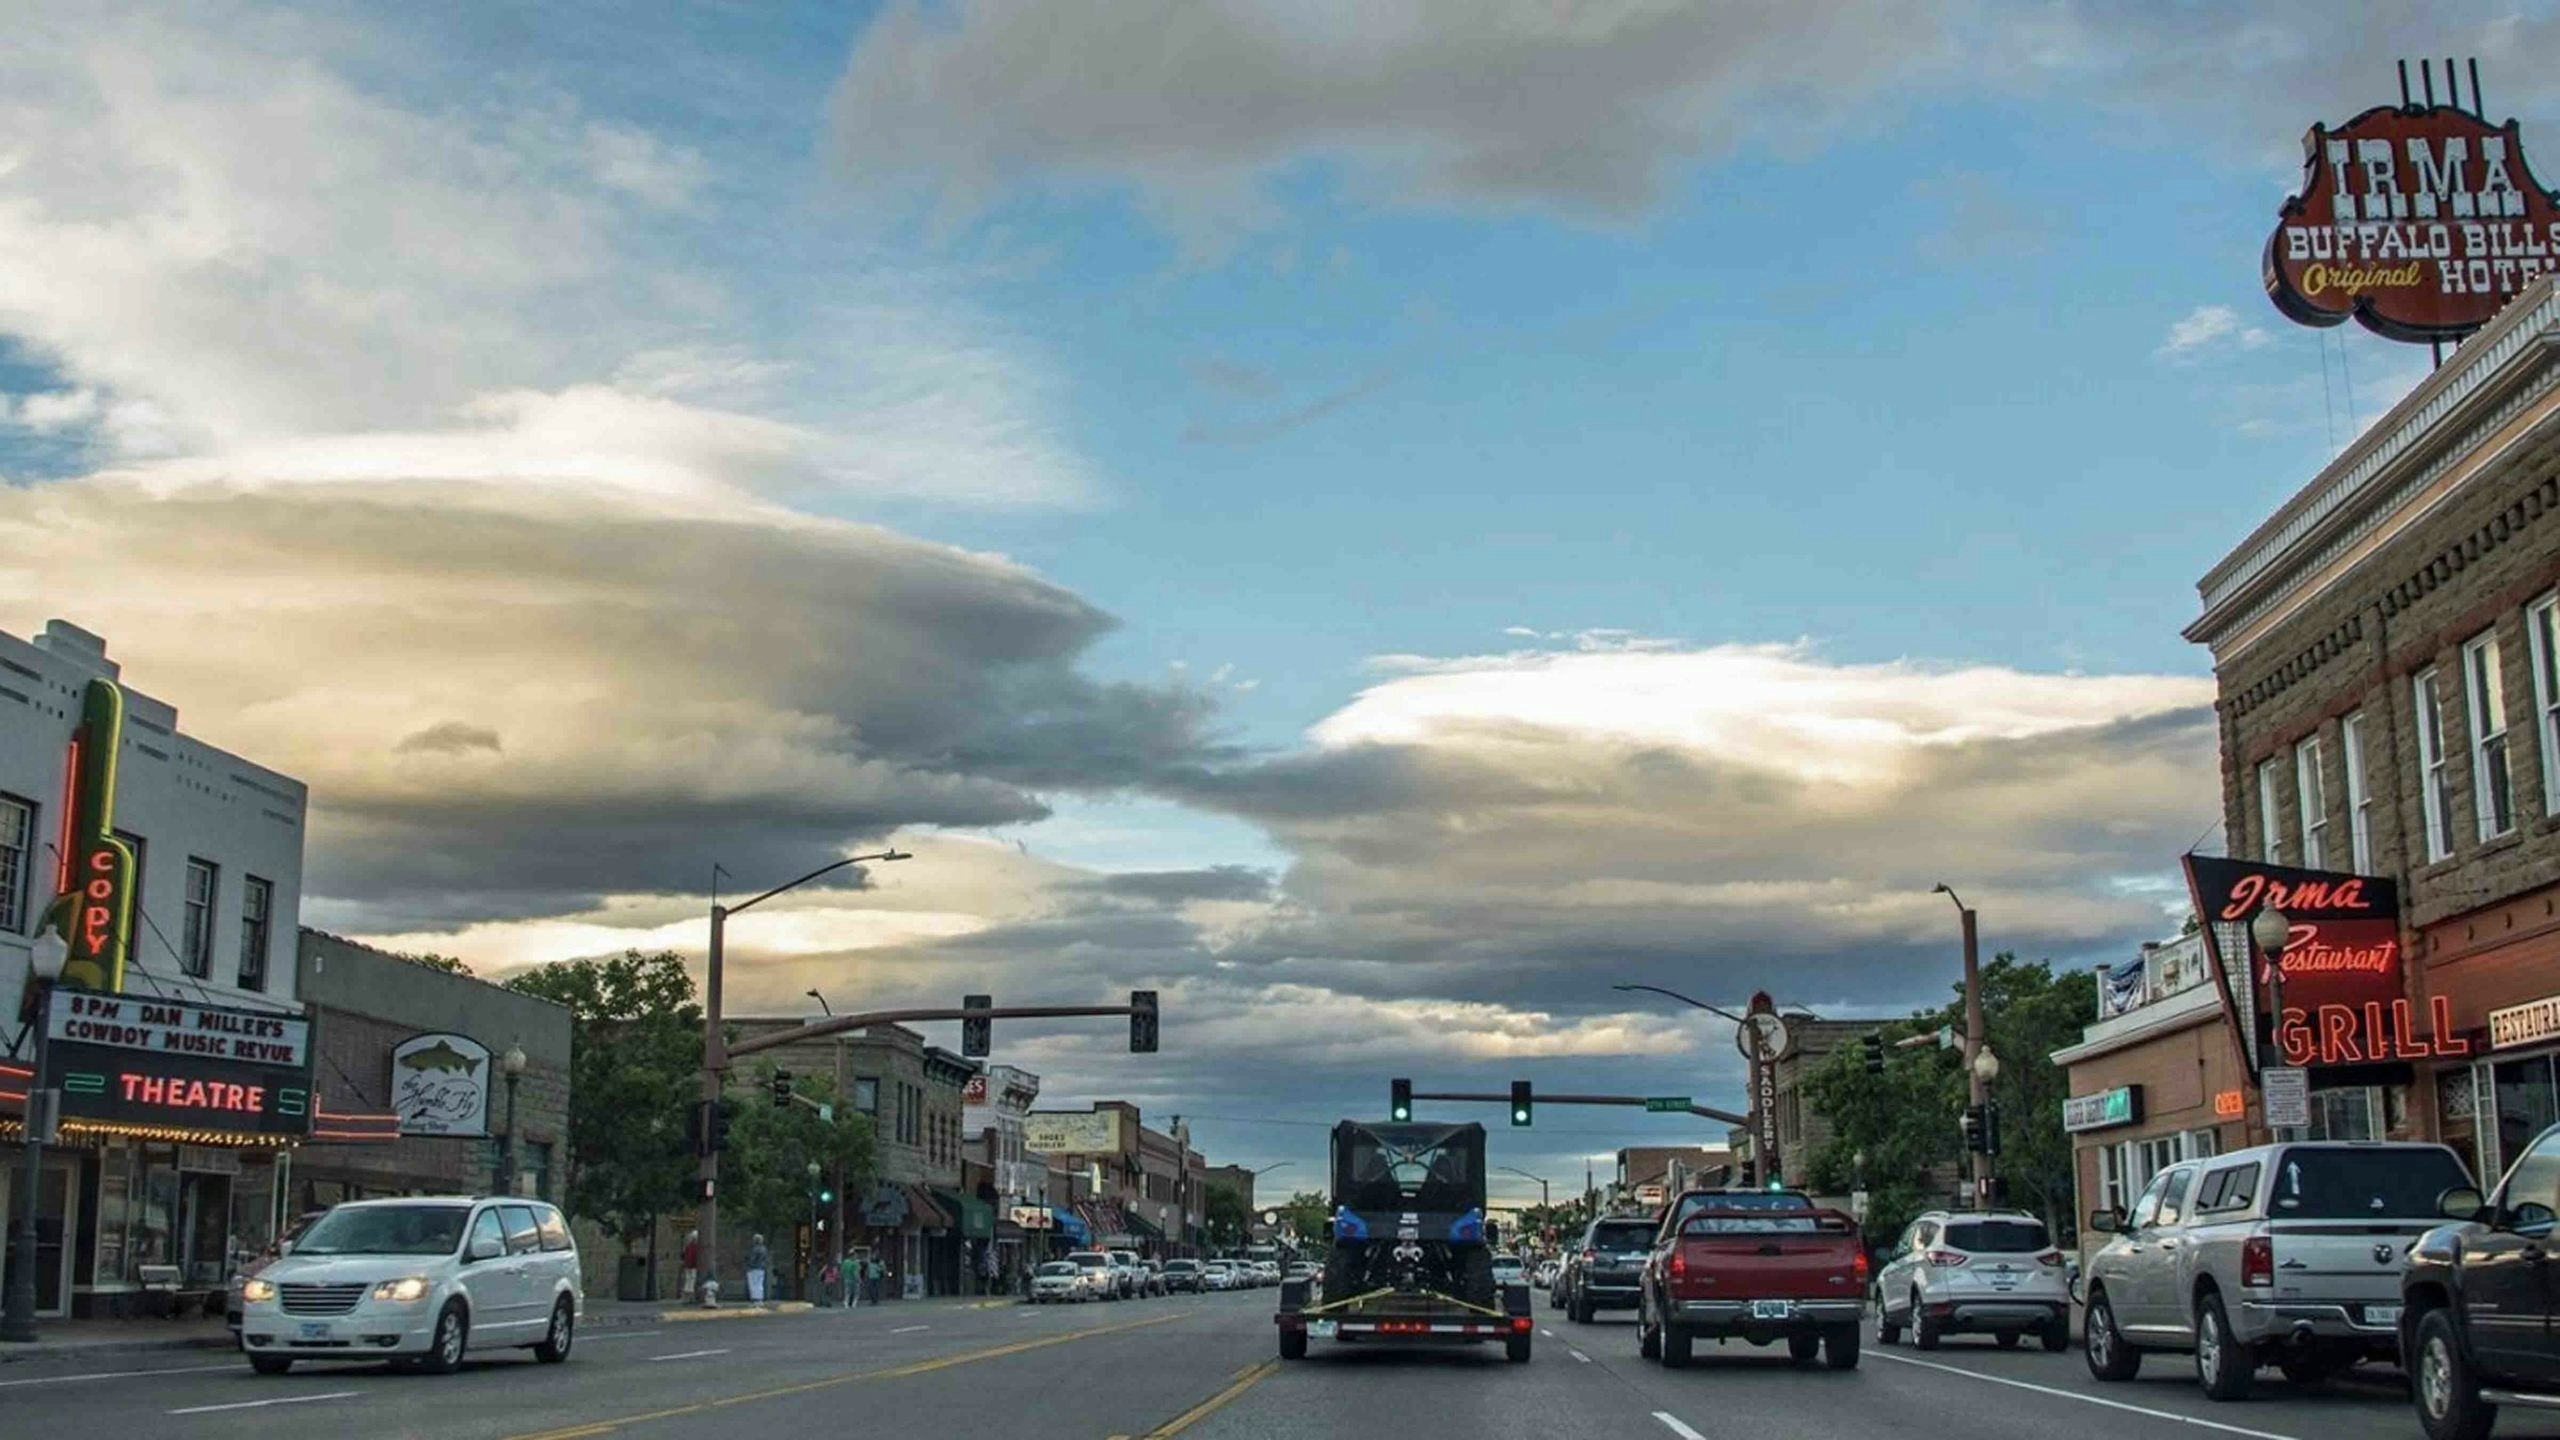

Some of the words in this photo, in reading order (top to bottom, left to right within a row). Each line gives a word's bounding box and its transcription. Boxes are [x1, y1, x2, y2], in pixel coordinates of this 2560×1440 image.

[2325, 136, 2527, 219] IRMA
[2286, 223, 2452, 261] BUFFALO
[2303, 261, 2422, 296] Original
[2438, 258, 2556, 294] HOTE
[2221, 874, 2370, 920] Irma
[2260, 923, 2397, 984] Restaurant
[65, 1019, 152, 1047] COWBOY
[164, 1031, 227, 1055] MUSIC
[233, 1040, 294, 1062] REVUE
[141, 1005, 182, 1027] DAN
[197, 1013, 284, 1038] MILLER'S
[2273, 994, 2468, 1066] GRILL
[120, 1073, 266, 1113] THEATRE
[1759, 1065, 1775, 1150] SADDLERY
